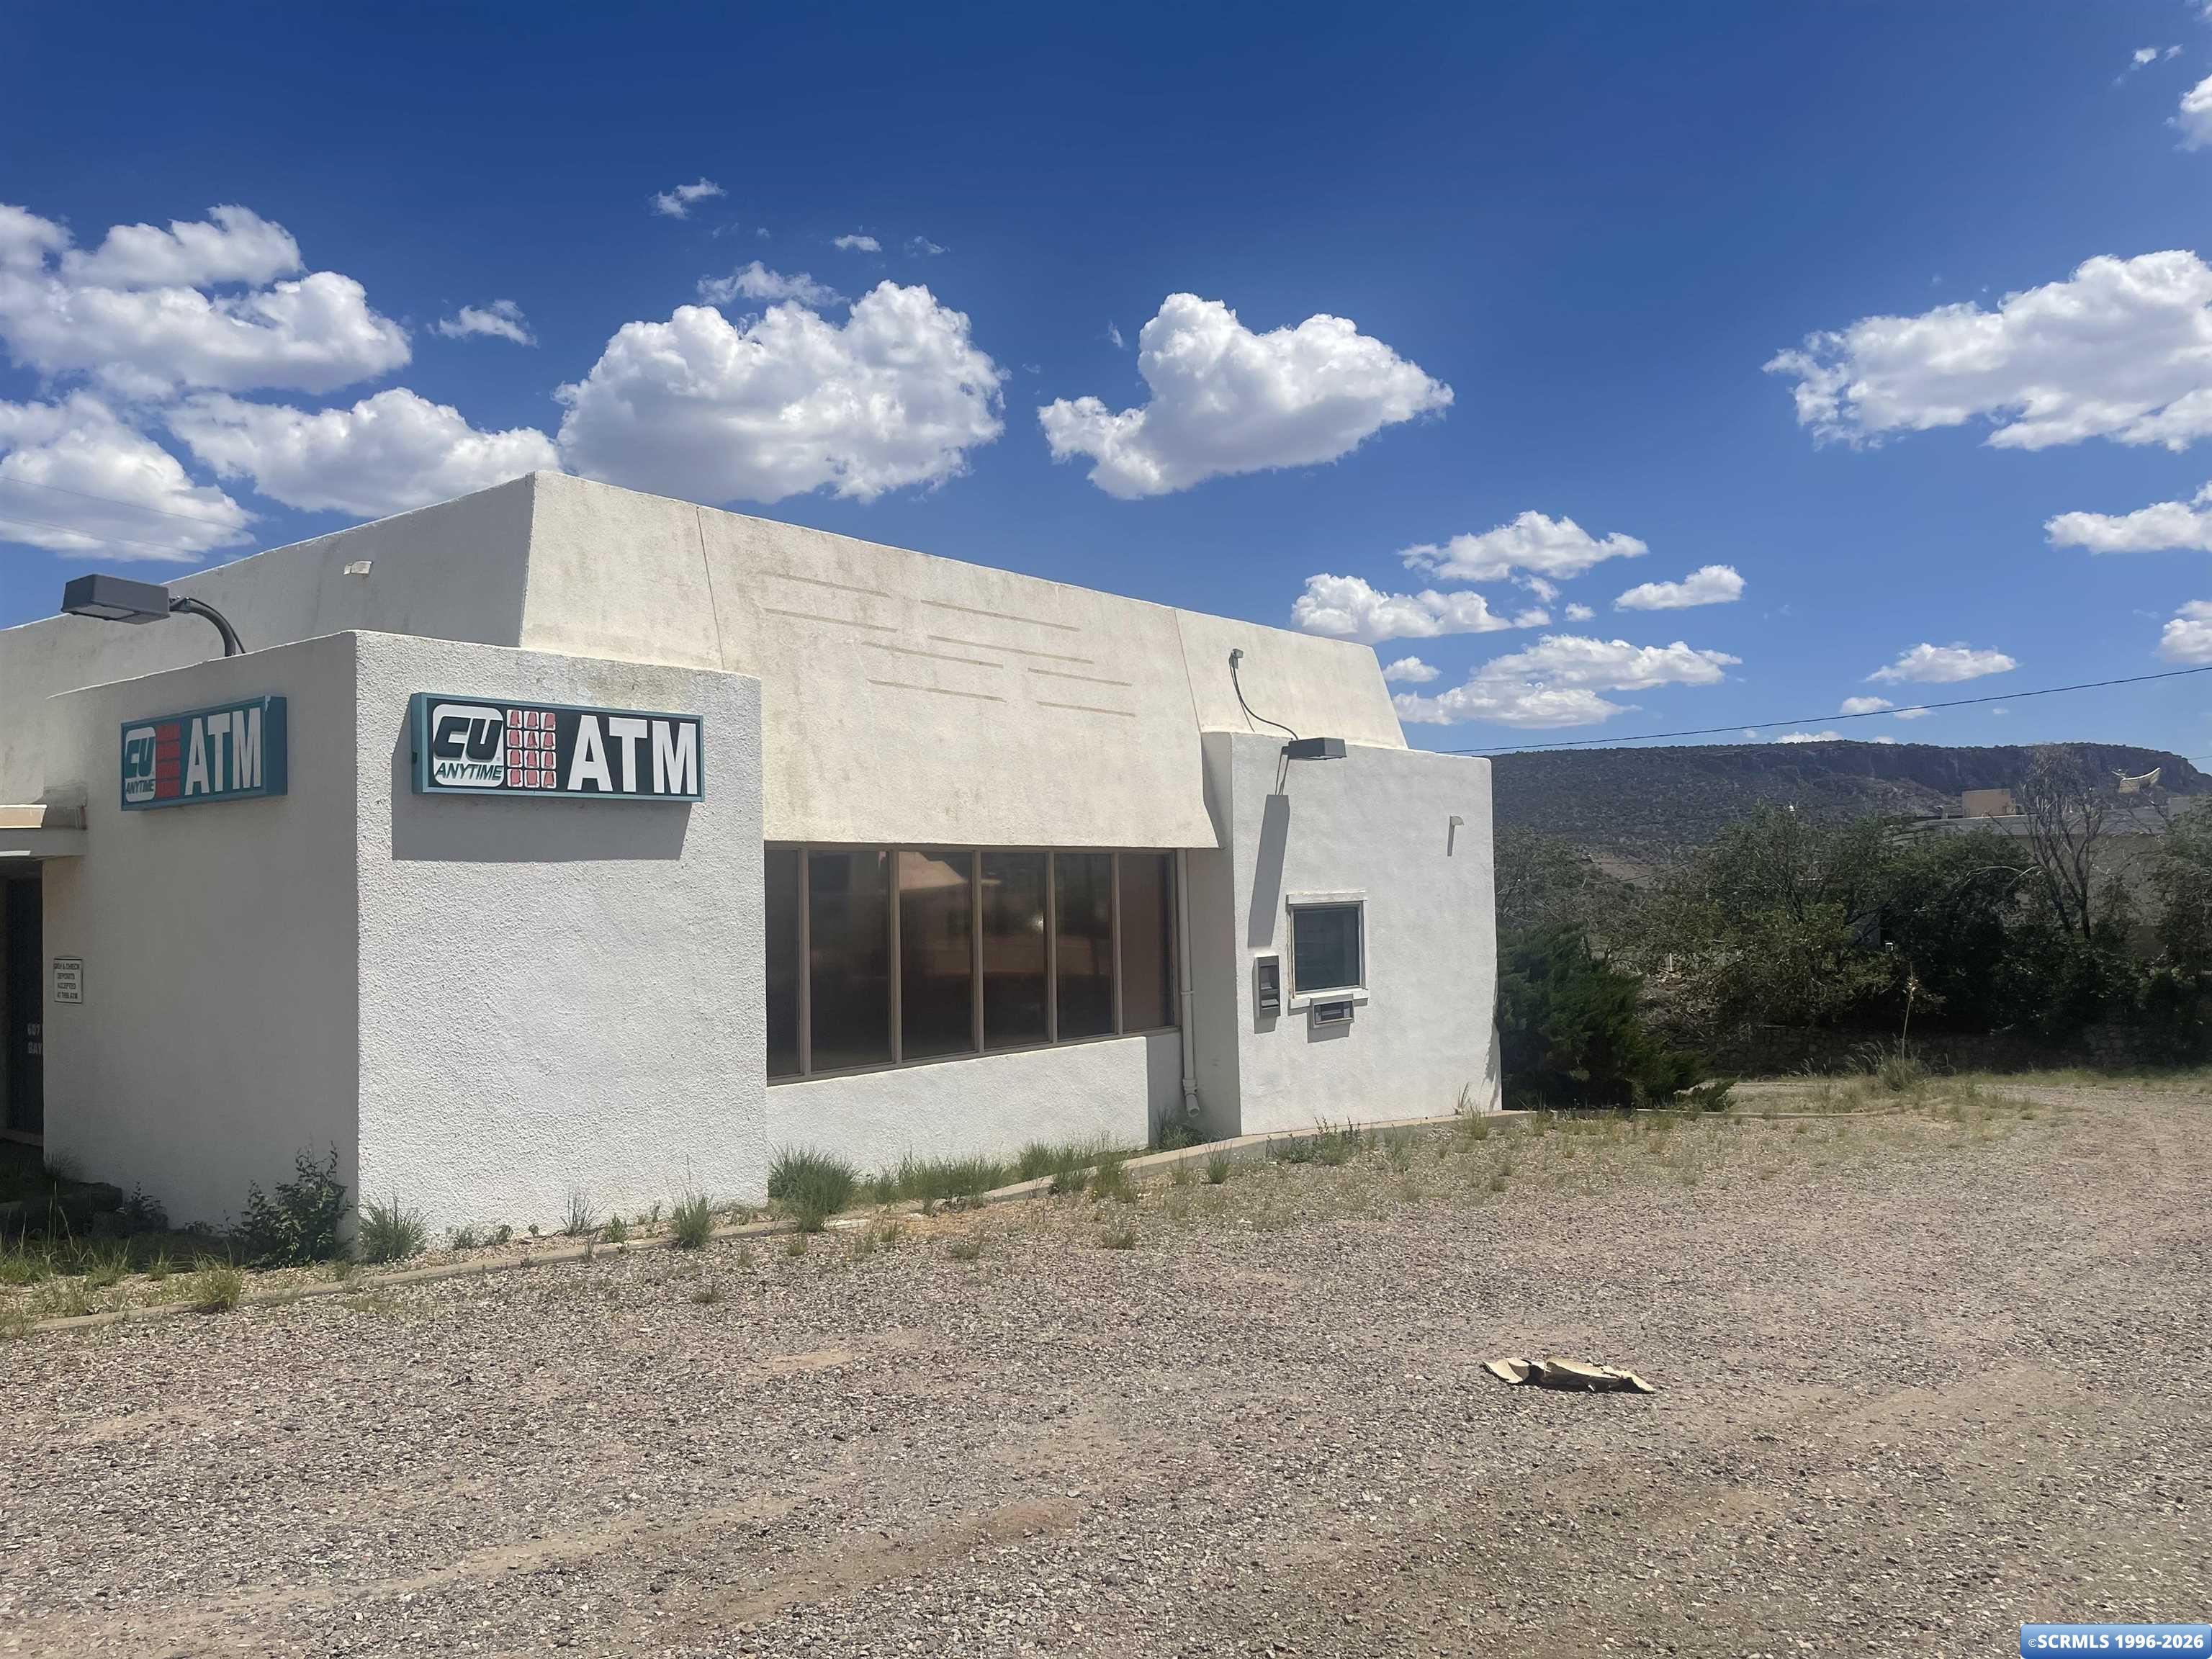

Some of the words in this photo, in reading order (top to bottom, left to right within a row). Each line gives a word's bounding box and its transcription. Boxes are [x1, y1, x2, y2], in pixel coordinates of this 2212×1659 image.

[125, 737, 156, 779] CU
[184, 707, 261, 796] ATM
[433, 716, 503, 762] CU
[567, 715, 698, 795] ATM
[126, 779, 155, 794] ANYTIME
[434, 763, 504, 781] ANYTIME
